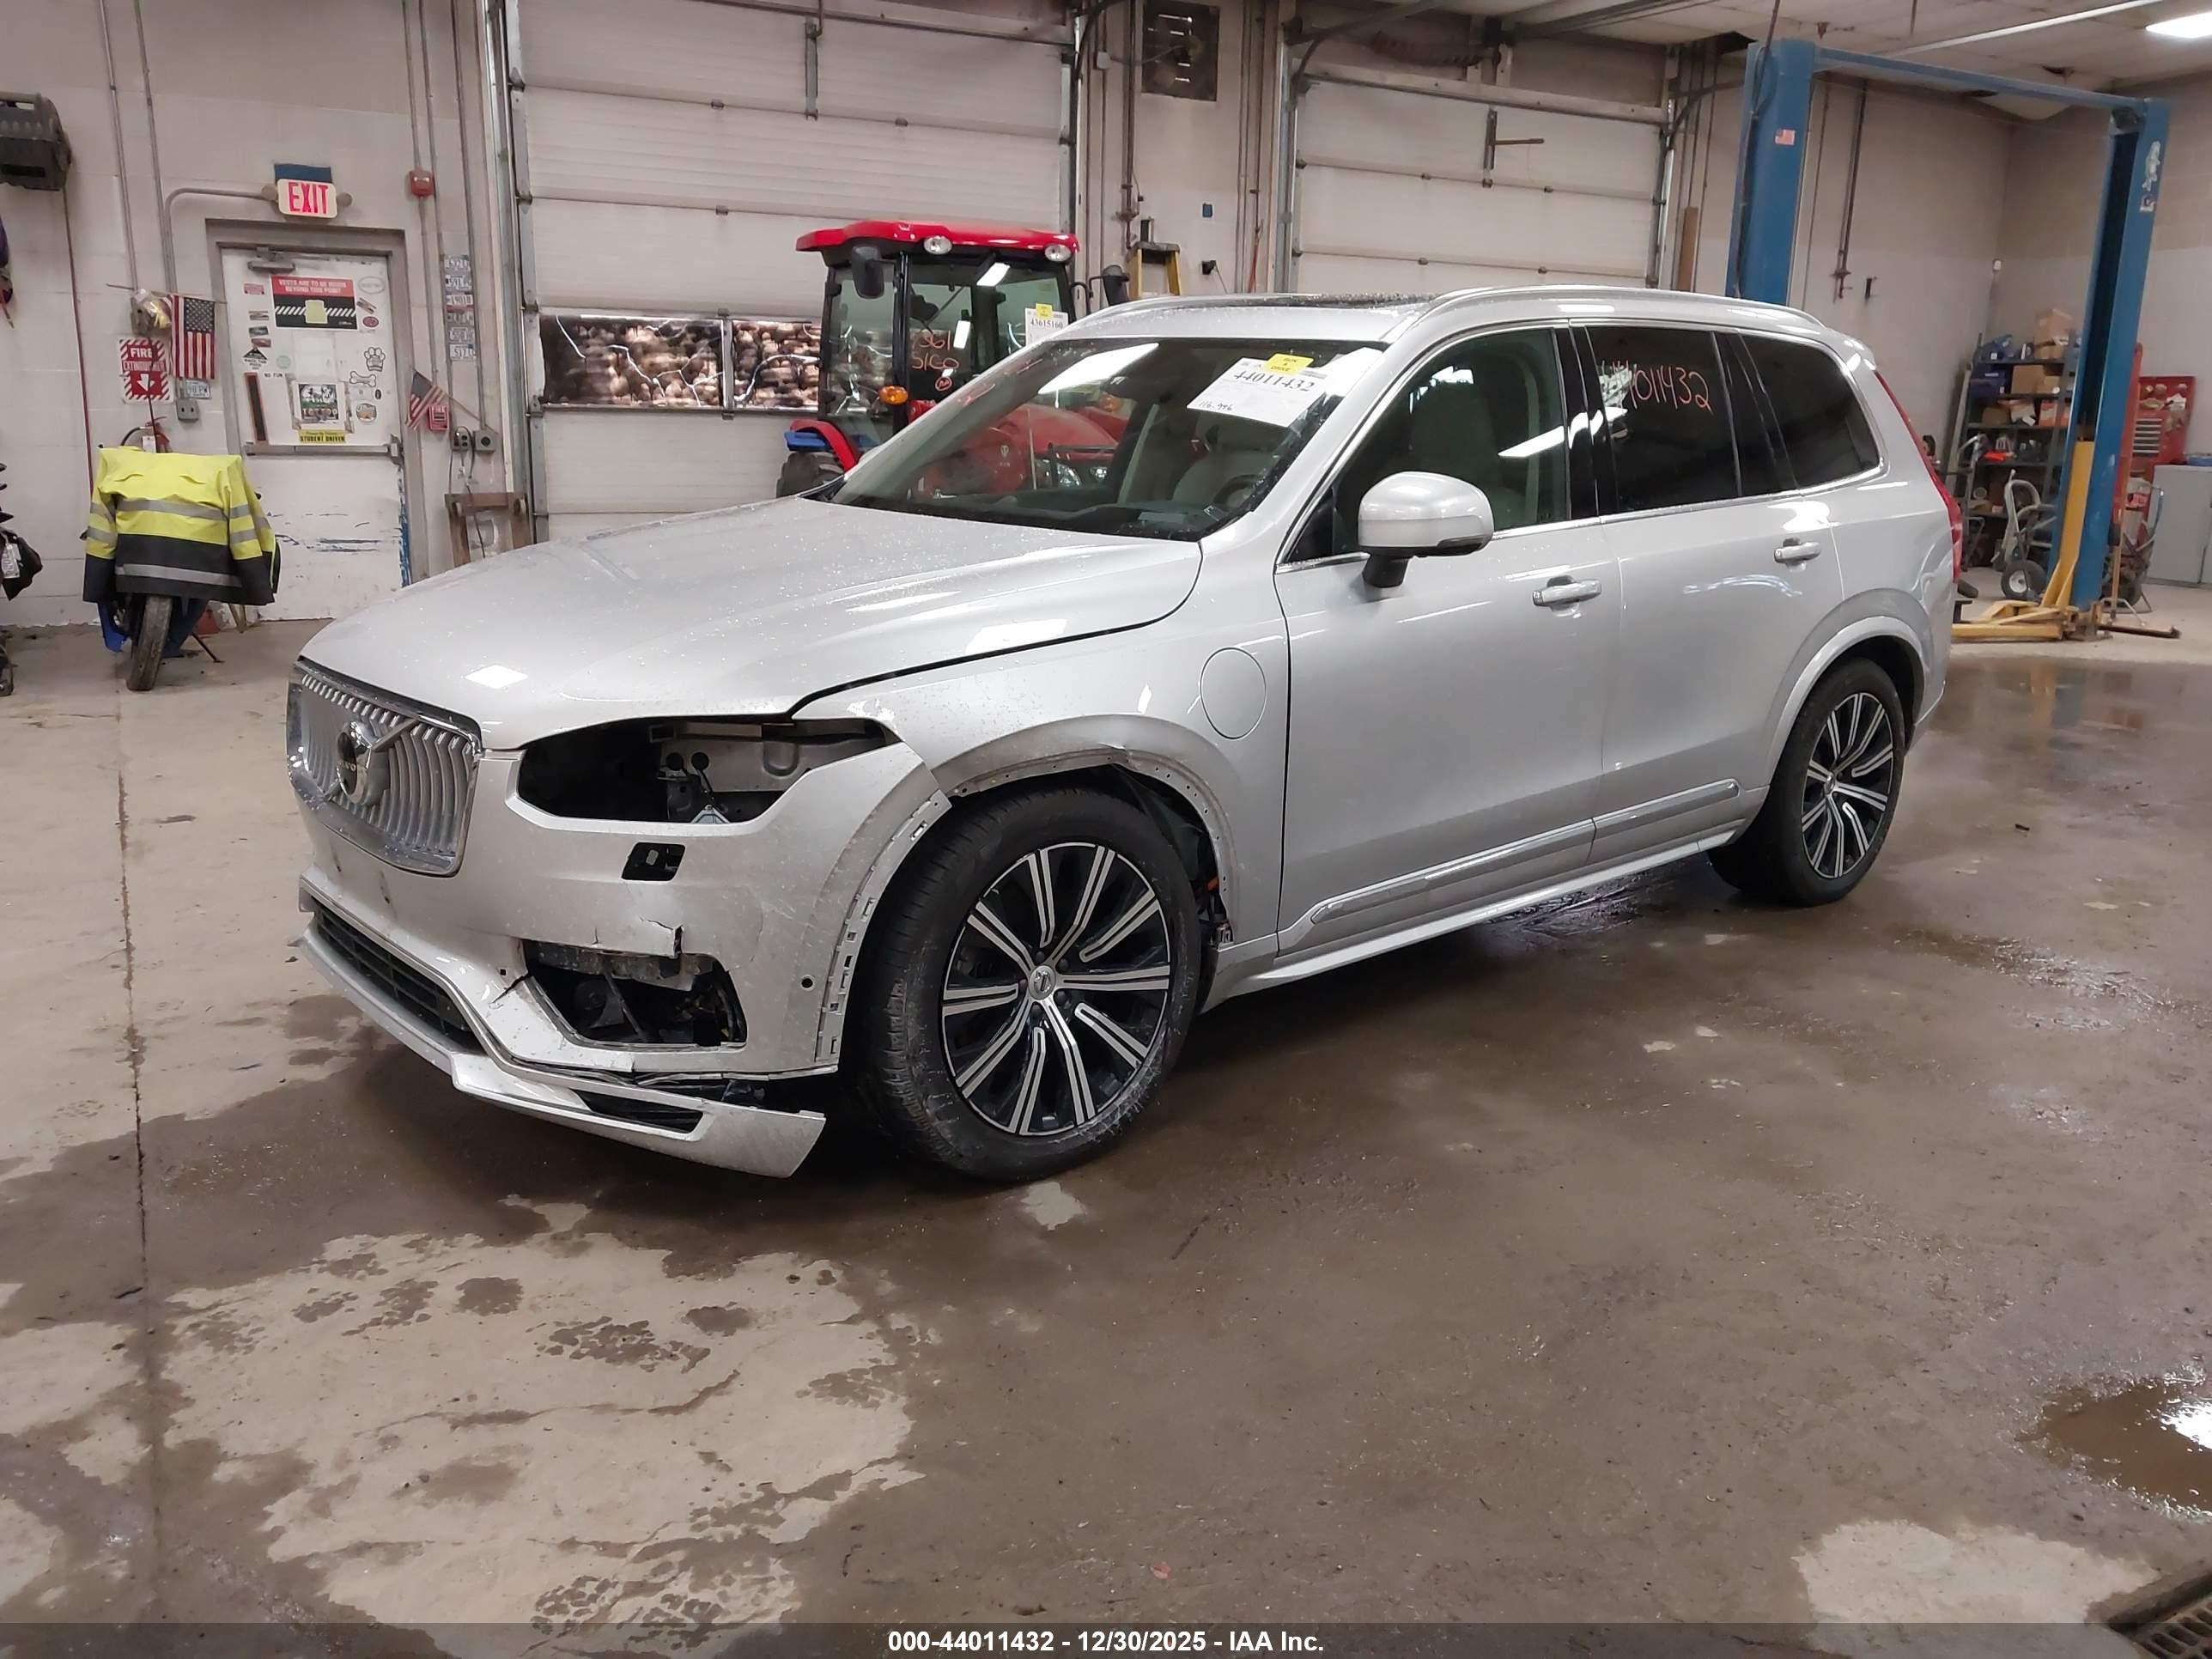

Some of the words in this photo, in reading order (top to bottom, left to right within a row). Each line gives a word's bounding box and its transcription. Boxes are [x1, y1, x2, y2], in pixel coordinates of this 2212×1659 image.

[288, 181, 329, 215] EXIT
[130, 347, 153, 358] FIRE
[1233, 371, 1316, 392] 44011432
